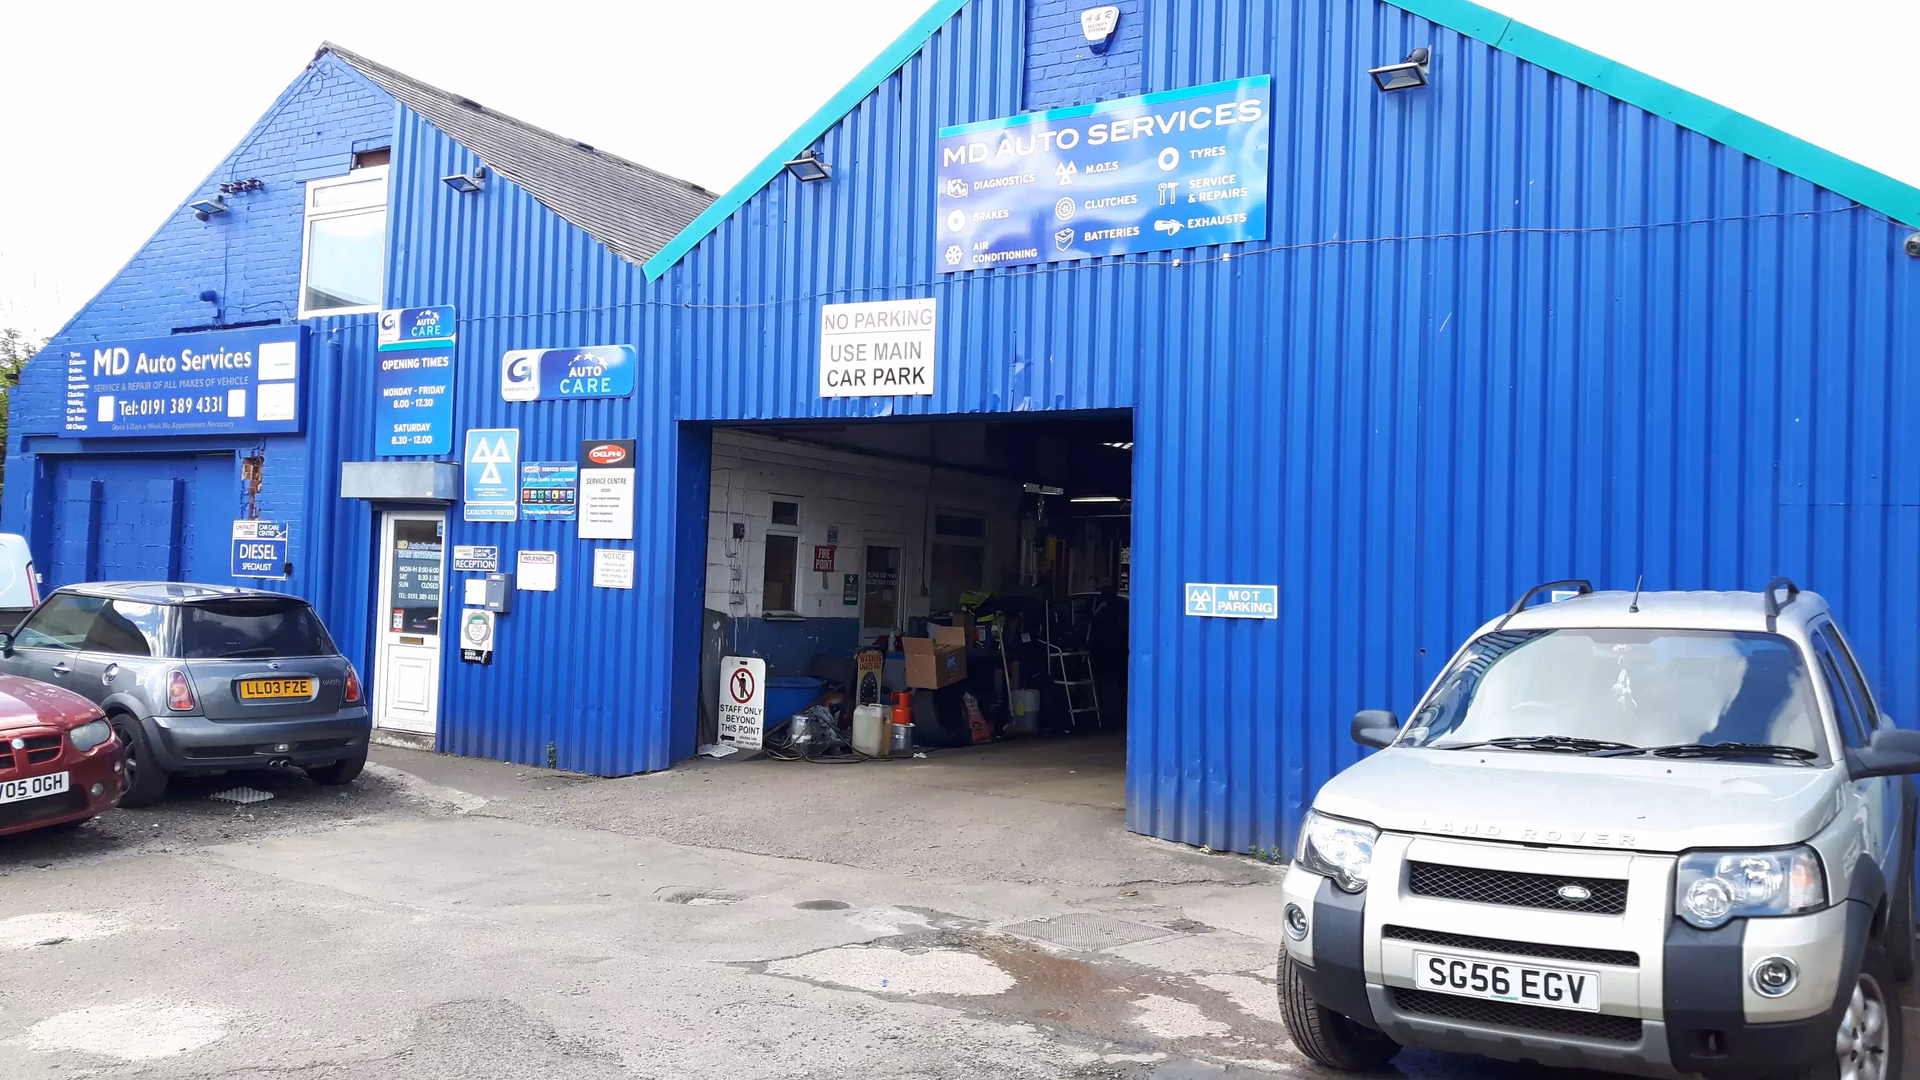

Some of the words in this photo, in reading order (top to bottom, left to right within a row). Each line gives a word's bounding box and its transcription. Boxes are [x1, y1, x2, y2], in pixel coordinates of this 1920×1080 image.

[1104, 10, 1112, 19] R
[942, 142, 989, 167] MD
[994, 128, 1080, 159] AUTO
[1087, 98, 1262, 146] SERVICES
[1189, 146, 1226, 159] TYRES
[1085, 161, 1119, 174] M.O.T.S
[974, 173, 1035, 191] DIAGNOSTICS
[1188, 175, 1236, 189] SERVICE
[1188, 193, 1196, 203] &
[1199, 187, 1248, 202] REPAIRS
[1084, 195, 1137, 210] CLUTCHES
[973, 209, 1009, 222] BRAKES
[1187, 213, 1247, 228] EXHAUSTS
[1084, 226, 1140, 241] BATTERIES
[973, 241, 989, 251] AIR
[972, 248, 1037, 263] CONDITIONING
[416, 318, 436, 326] AUTO
[825, 314, 848, 330] NO
[855, 309, 932, 328] PARKING
[411, 325, 441, 336] CARE
[830, 344, 866, 362] USE
[874, 341, 921, 361] MAIN
[94, 347, 129, 376] MD
[135, 353, 176, 374] Auto
[181, 347, 252, 371] Services
[382, 358, 419, 370] OPENING
[422, 356, 449, 368] TIMES
[568, 366, 602, 377] AUTO
[827, 369, 866, 387] CAR
[873, 366, 925, 385] PARK
[94, 384, 120, 393] SERVICE
[128, 381, 151, 390] REPAIR
[152, 381, 162, 389] OF
[164, 380, 177, 389] ALL
[179, 378, 204, 388] MAKES
[205, 378, 216, 387] OF
[216, 376, 248, 386] VEHICLE
[383, 387, 412, 396] MONDAY
[418, 386, 445, 395] FRIDAY
[560, 378, 611, 394] CARE
[119, 400, 138, 416] Tel:
[140, 399, 164, 415] 0191
[169, 398, 192, 414] 389
[195, 396, 222, 413] 4331
[393, 399, 409, 408] 8.00
[416, 398, 433, 407] 17.30
[129, 423, 142, 432] Days
[147, 421, 162, 430] Week
[171, 420, 205, 431] Appointment
[207, 420, 234, 430] Necessary
[394, 423, 430, 432] SATURDAY
[391, 436, 407, 444] 8.30
[413, 436, 432, 444] 12.00
[240, 544, 277, 559] DIESEL
[819, 548, 830, 559] FIRE
[456, 560, 495, 568] RECEPTION
[816, 559, 832, 570] POINT
[1228, 590, 1260, 601] MOT
[1218, 602, 1272, 612] PARKING
[860, 654, 881, 662] WARNING
[247, 682, 280, 694] LL03
[284, 681, 307, 693] FZE
[720, 704, 742, 713] STAFF
[744, 707, 762, 715] ONLY
[726, 715, 755, 724] BEYOND
[721, 724, 736, 732] THIS
[739, 726, 760, 734] POINT
[33, 774, 62, 793] OGH
[1420, 819, 1501, 836] LAND
[1521, 829, 1636, 846] ROVER
[1429, 957, 1510, 995] SG56
[1521, 969, 1585, 1004] EGV
